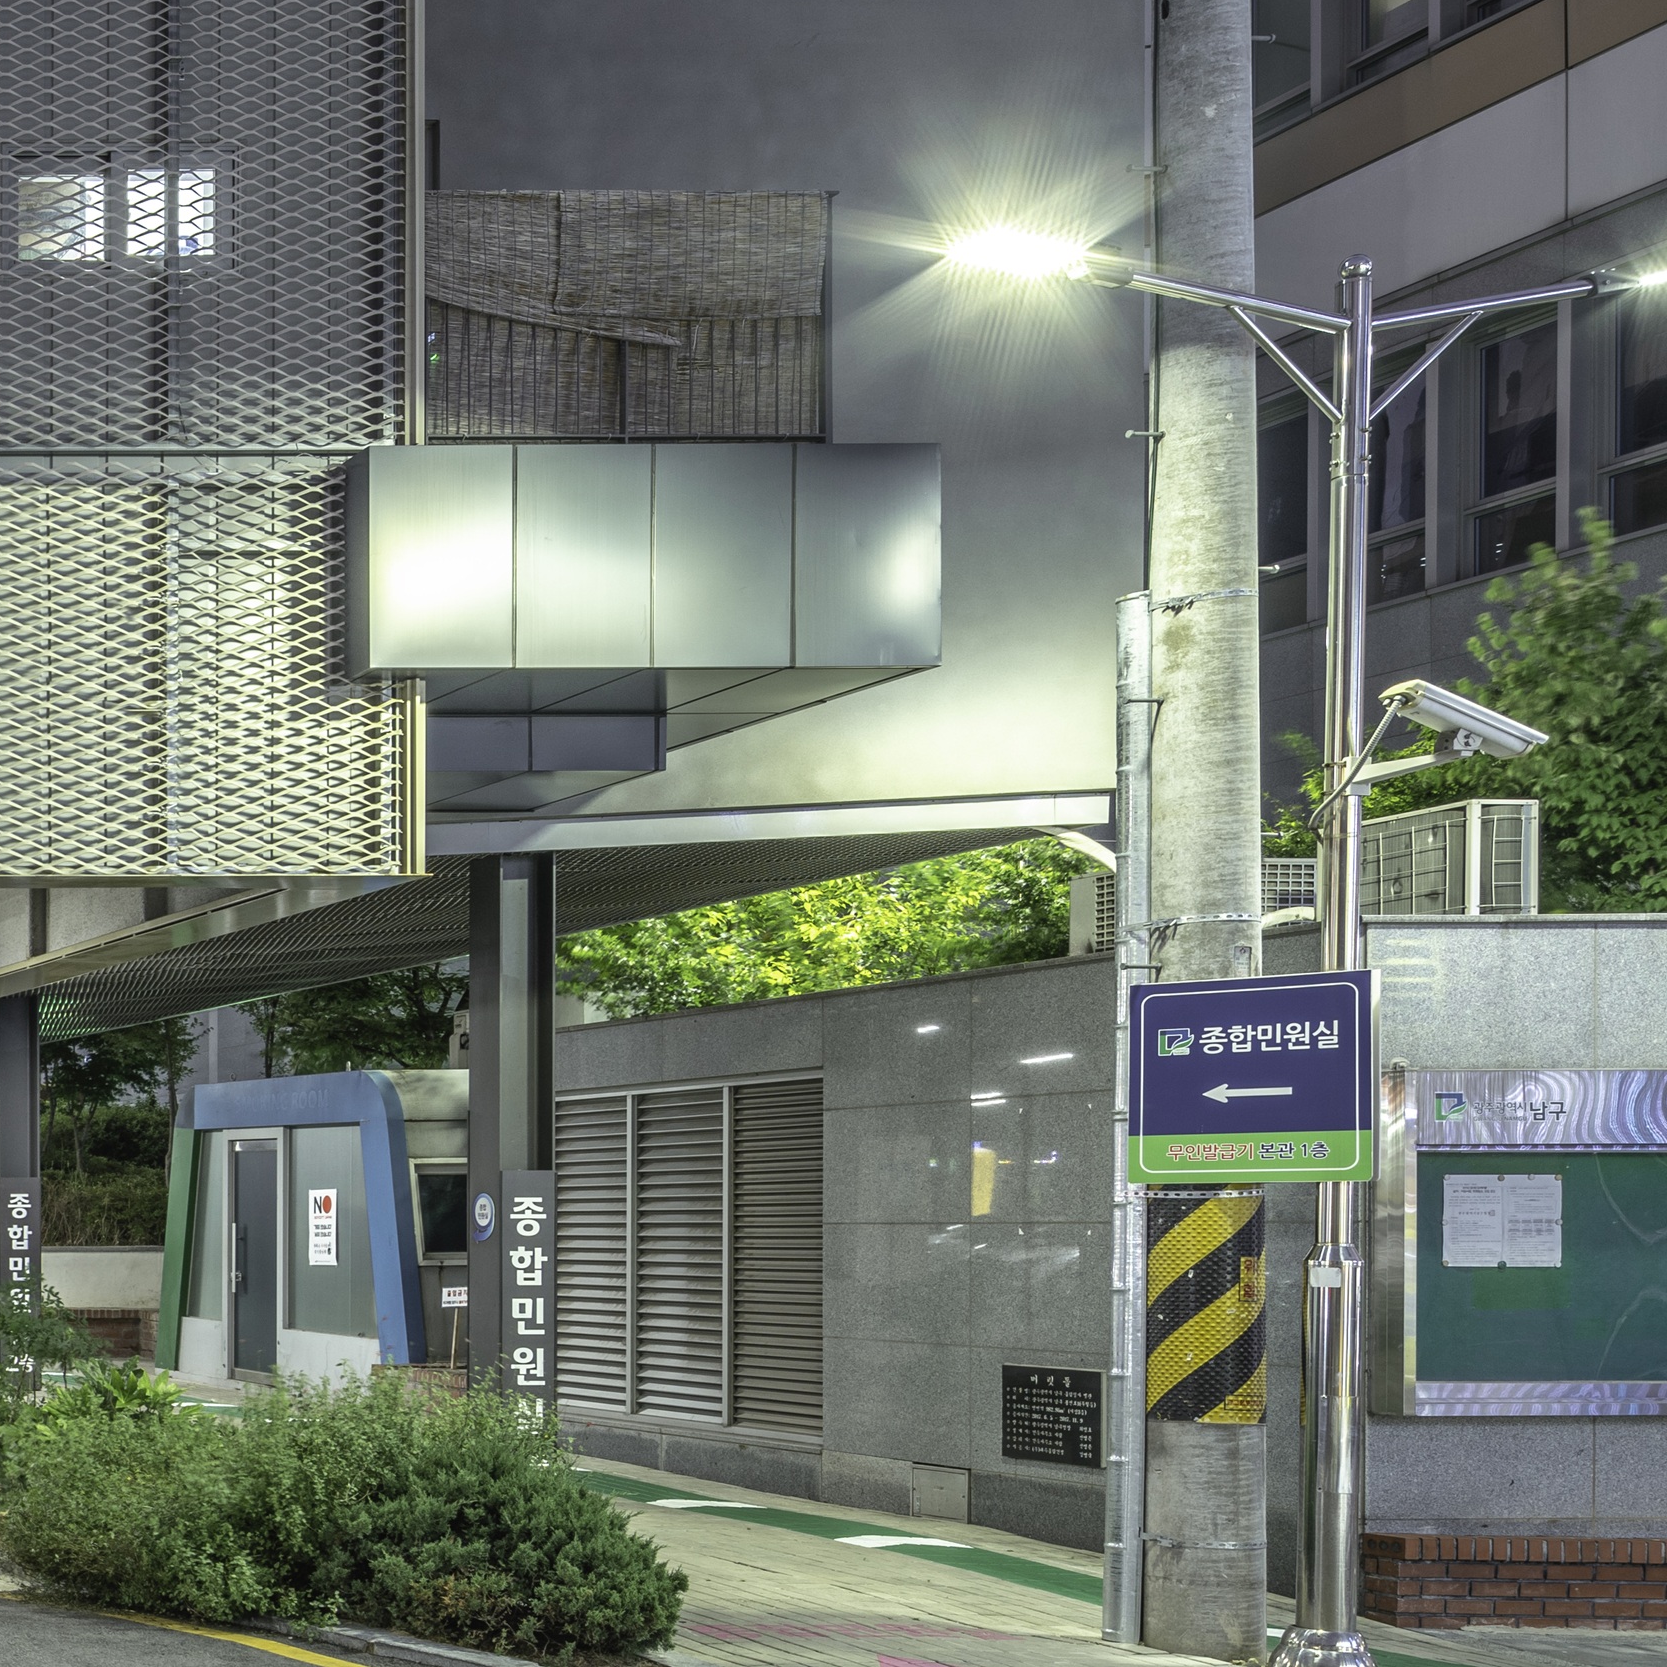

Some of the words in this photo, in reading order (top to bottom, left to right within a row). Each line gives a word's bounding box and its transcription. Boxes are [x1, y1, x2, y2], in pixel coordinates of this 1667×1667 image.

[1198, 1019, 1340, 1055] 종합민원실
[1530, 1101, 1567, 1121] 남구
[1166, 1143, 1254, 1161] 무인발급기
[1258, 1142, 1295, 1159] 본관
[1301, 1141, 1329, 1159] 1층
